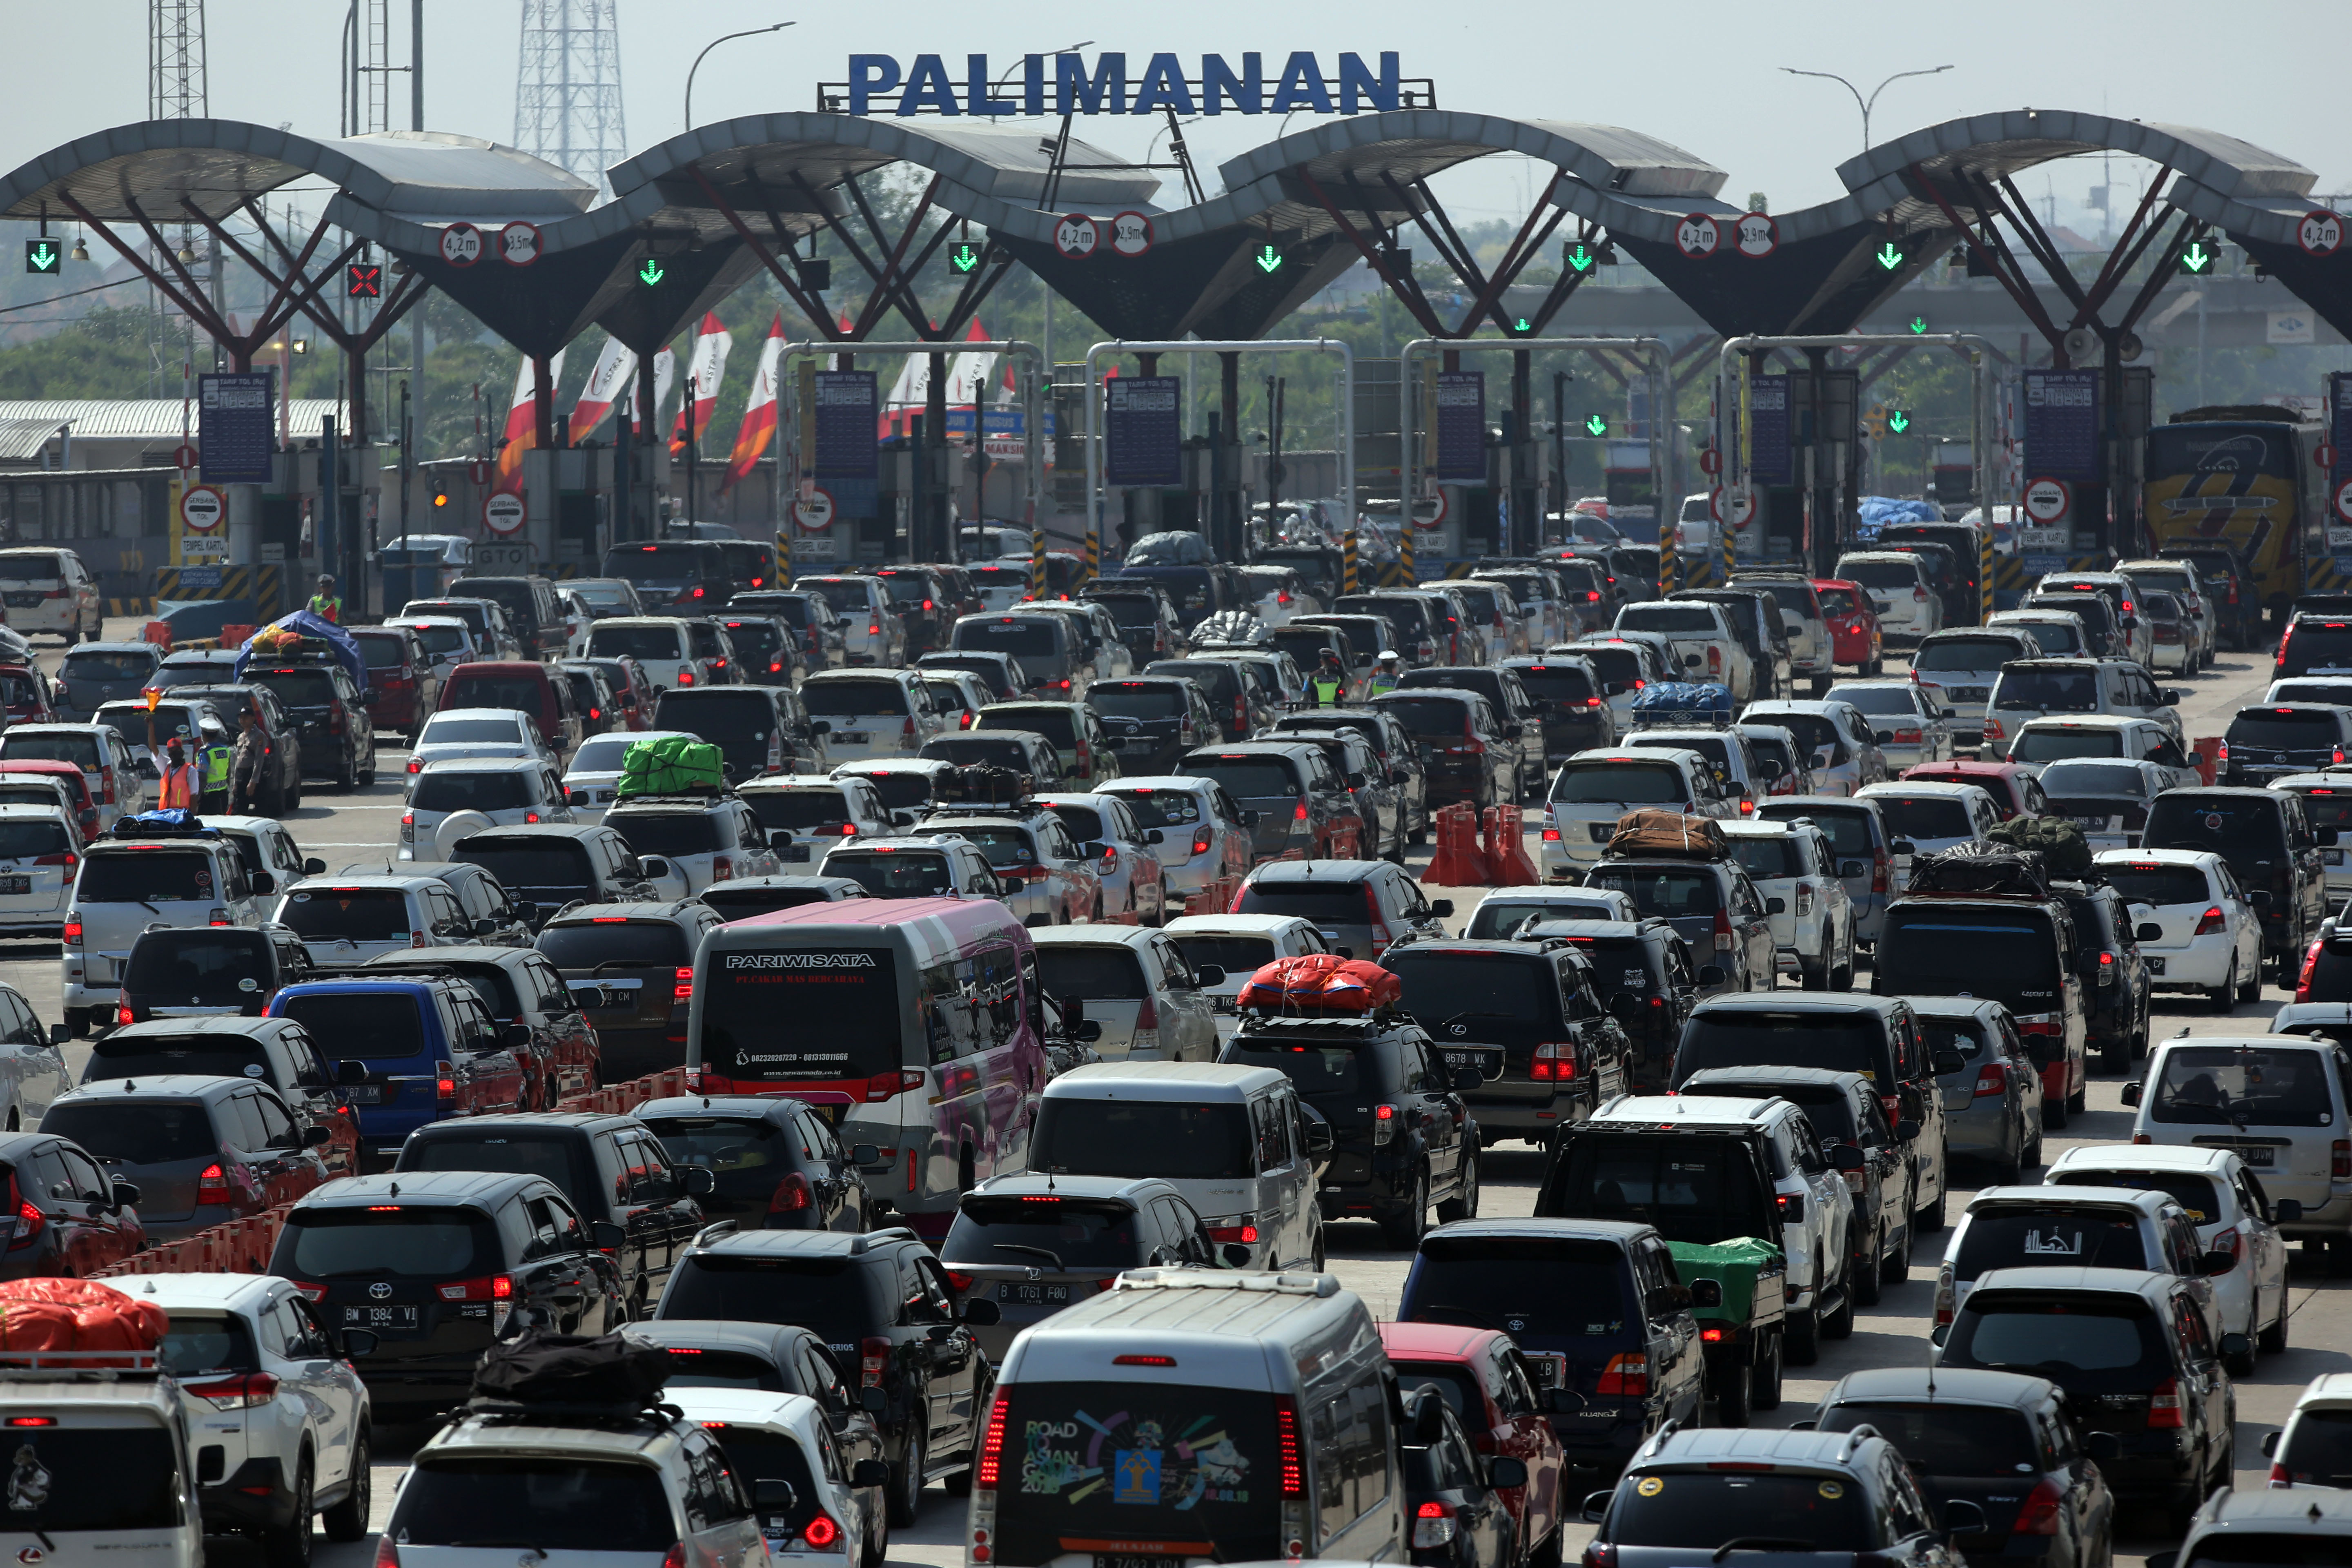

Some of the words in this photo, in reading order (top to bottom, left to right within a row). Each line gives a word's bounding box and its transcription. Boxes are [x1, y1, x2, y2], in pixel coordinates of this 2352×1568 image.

[849, 51, 1399, 116] PALIMANAN
[189, 497, 217, 505] GERBANG
[480, 533, 523, 544] GTO
[2330, 531, 2352, 542] TEMPE
[726, 954, 875, 968] PARIWISATA
[2154, 960, 2163, 968] CP
[786, 975, 805, 983] MAS
[808, 975, 865, 984] BERCAHAYA
[618, 991, 630, 1001] CM
[1221, 997, 1235, 1007] TKF
[751, 1053, 797, 1062] 082320207220
[803, 1053, 849, 1061] 081313011666
[1446, 1053, 1466, 1063] 8678
[1474, 1054, 1485, 1064] WK
[368, 1087, 379, 1097] XM
[1000, 1284, 1007, 1298] B
[1018, 1285, 1041, 1298] 1761
[345, 1307, 359, 1321] BM
[370, 1307, 392, 1321] 1384
[404, 1307, 415, 1320] VI
[1024, 1421, 1078, 1438] ROAD
[1027, 1437, 1049, 1450] TO
[1022, 1450, 1079, 1466] ASIAN
